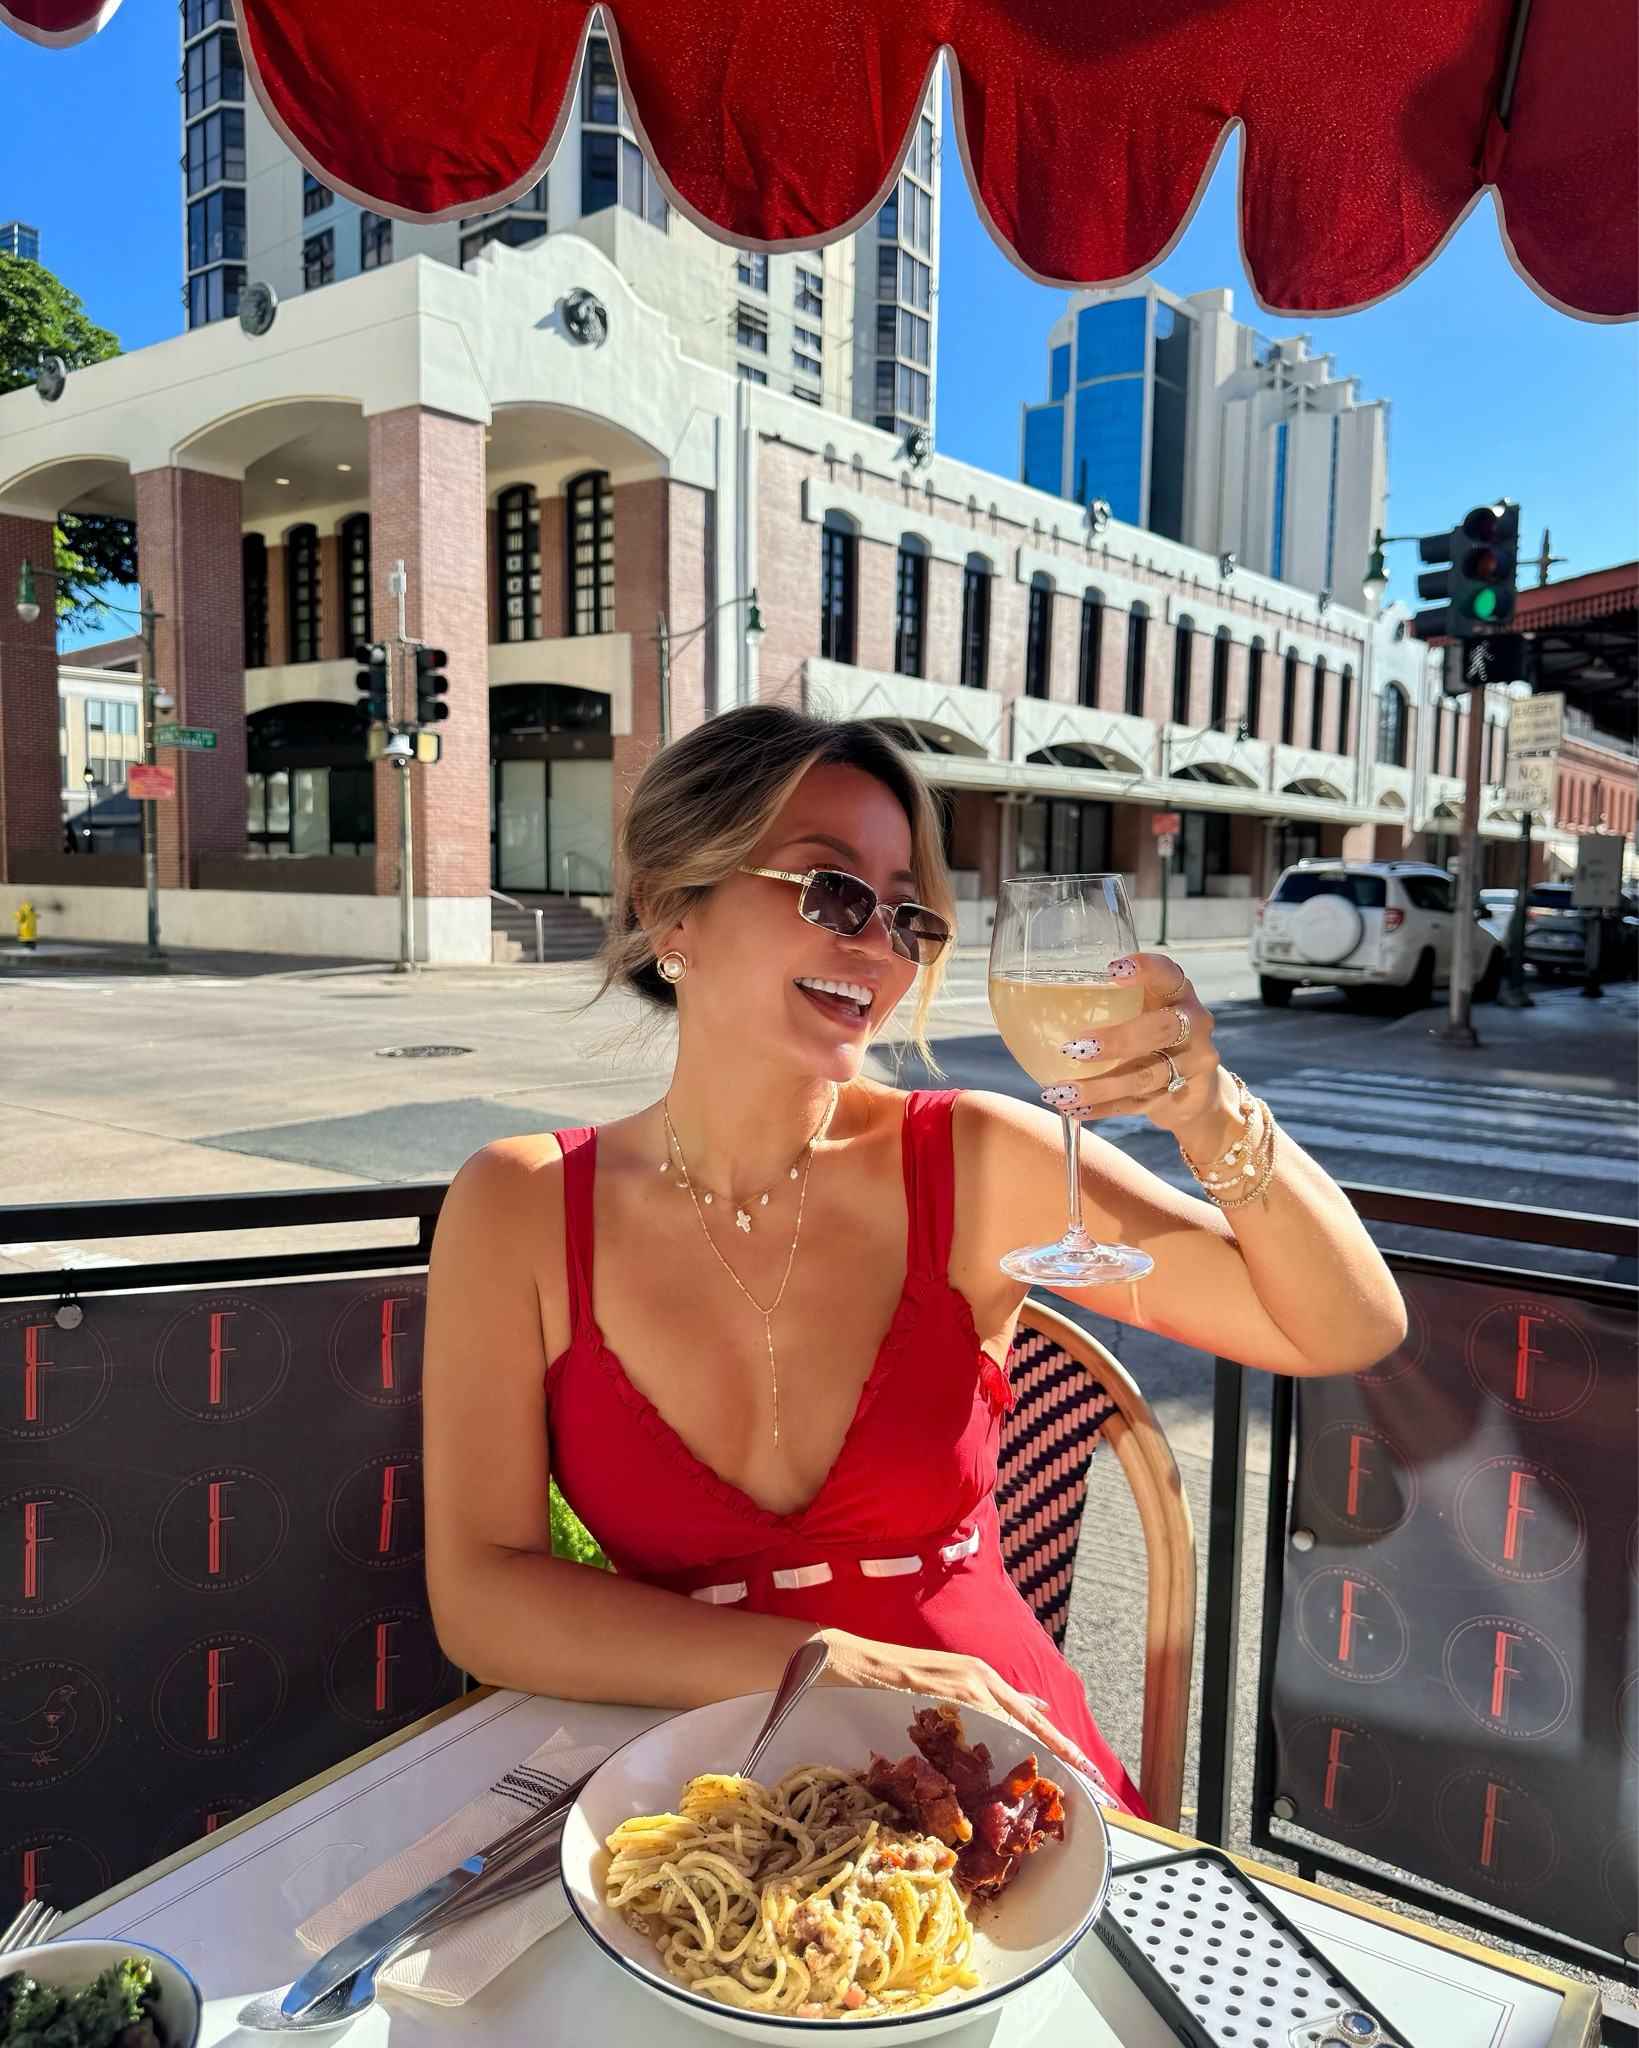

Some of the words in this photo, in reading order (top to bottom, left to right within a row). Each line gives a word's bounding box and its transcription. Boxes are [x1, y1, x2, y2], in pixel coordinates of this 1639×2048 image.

[1518, 764, 1543, 781] NO
[4, 1311, 58, 1328] CHINATO
[210, 1312, 237, 1404] F
[382, 1298, 409, 1388] F
[1515, 1315, 1544, 1400] F
[25, 1324, 55, 1421] F
[365, 1453, 420, 1469] CHINATOW
[1347, 1435, 1373, 1515] F
[25, 1501, 54, 1597] F
[209, 1481, 235, 1574] F
[379, 1464, 410, 1552] F
[1503, 1471, 1536, 1560] F
[1339, 1579, 1366, 1661] F
[208, 1646, 235, 1740] F
[376, 1620, 402, 1711] F
[1491, 1631, 1522, 1717] F
[1324, 1728, 1355, 1809] F
[1480, 1782, 1511, 1866] F
